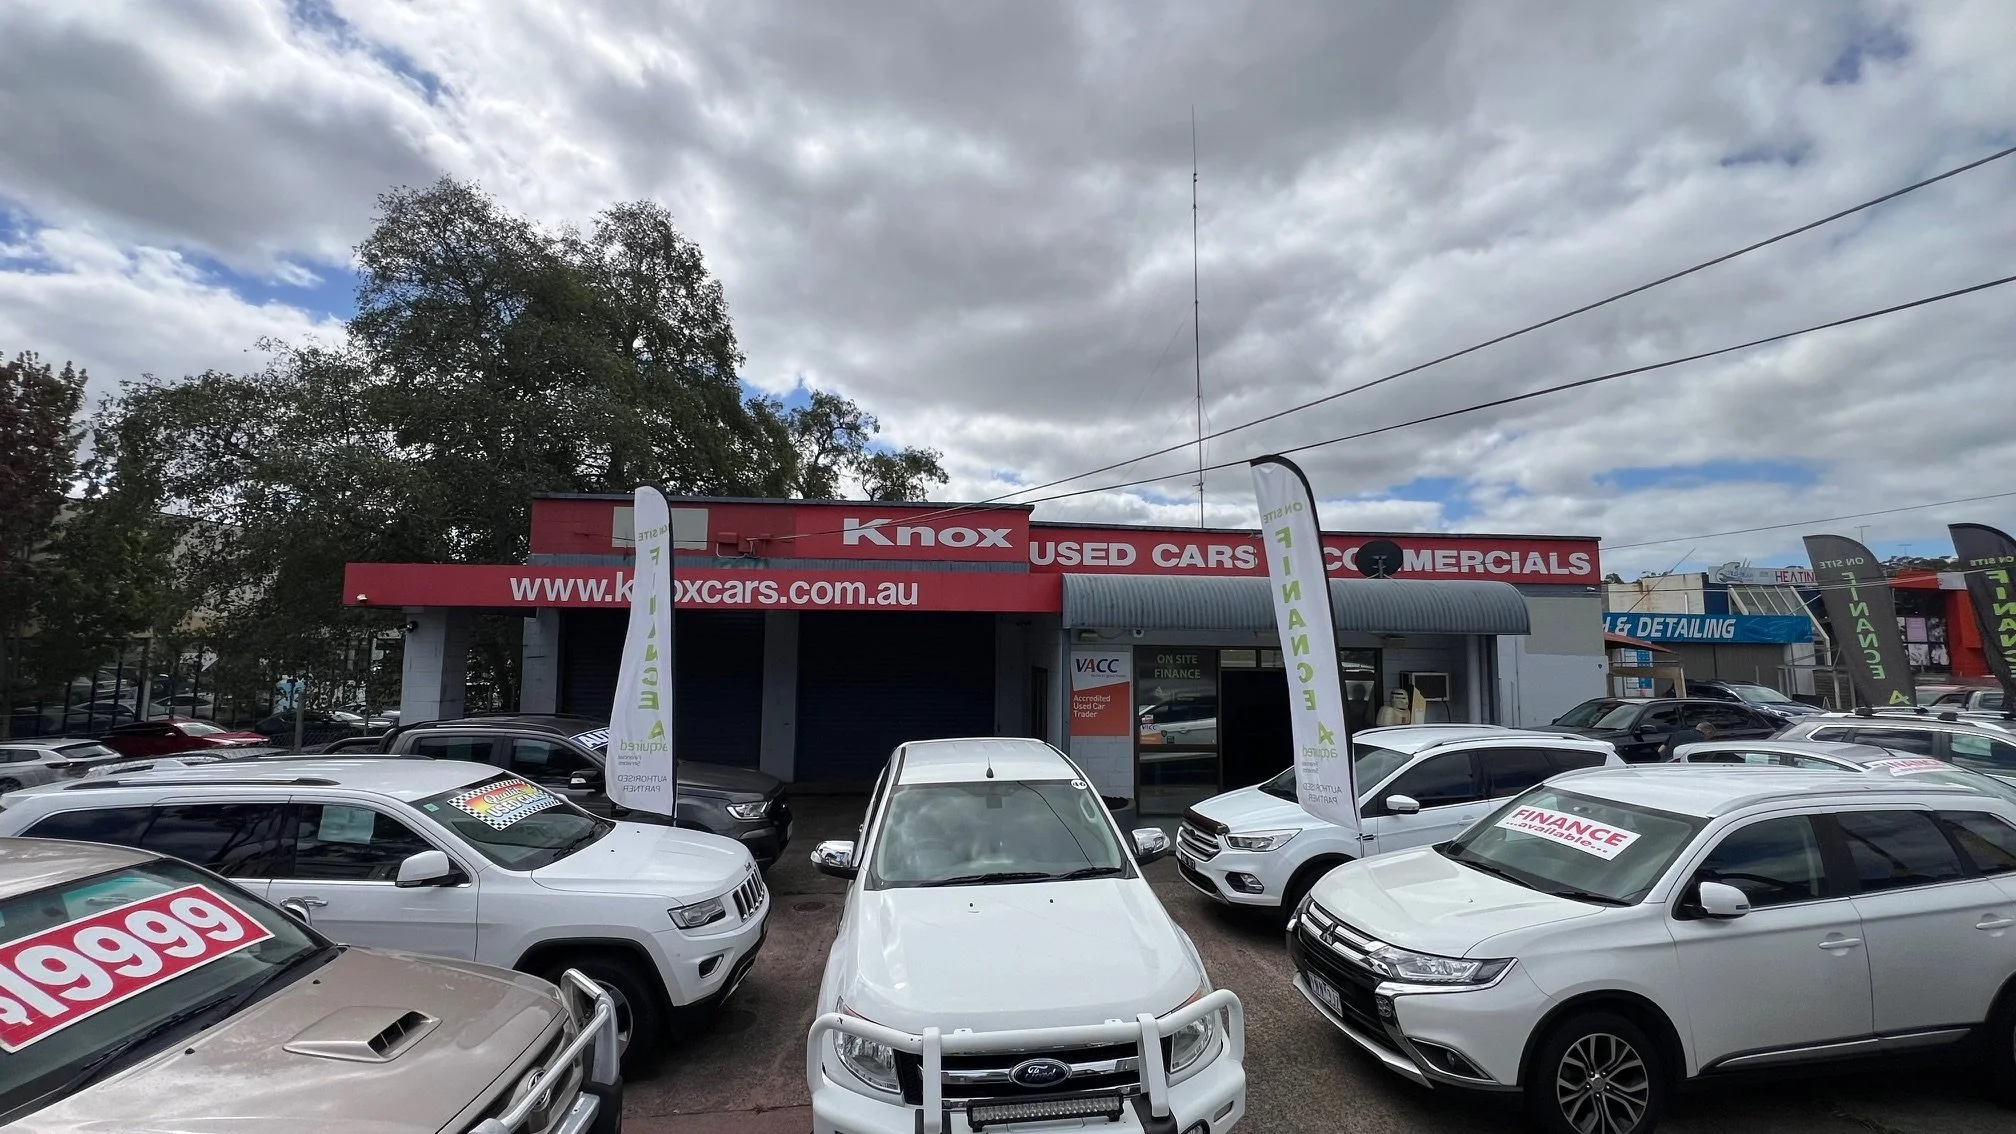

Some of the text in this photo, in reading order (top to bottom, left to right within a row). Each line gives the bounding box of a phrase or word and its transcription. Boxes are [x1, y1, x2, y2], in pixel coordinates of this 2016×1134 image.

[843, 518, 1013, 548] Knox
[1029, 541, 1591, 575] USED CARS CMERCIALS
[1775, 570, 1815, 583] HEATIN
[510, 571, 919, 606] www.kxcars.com.au
[1615, 616, 1632, 637] &
[1636, 617, 1736, 639] DETAILING
[1075, 658, 1119, 673] VACC
[1157, 654, 1198, 664] ON SITE
[1154, 668, 1201, 679] FINANCE
[1073, 702, 1106, 710] Used Car
[1073, 710, 1098, 718] Trader
[578, 730, 609, 748] AU
[482, 786, 524, 805] Qualit
[486, 798, 522, 818] USED
[1512, 809, 1628, 847] FINANCE
